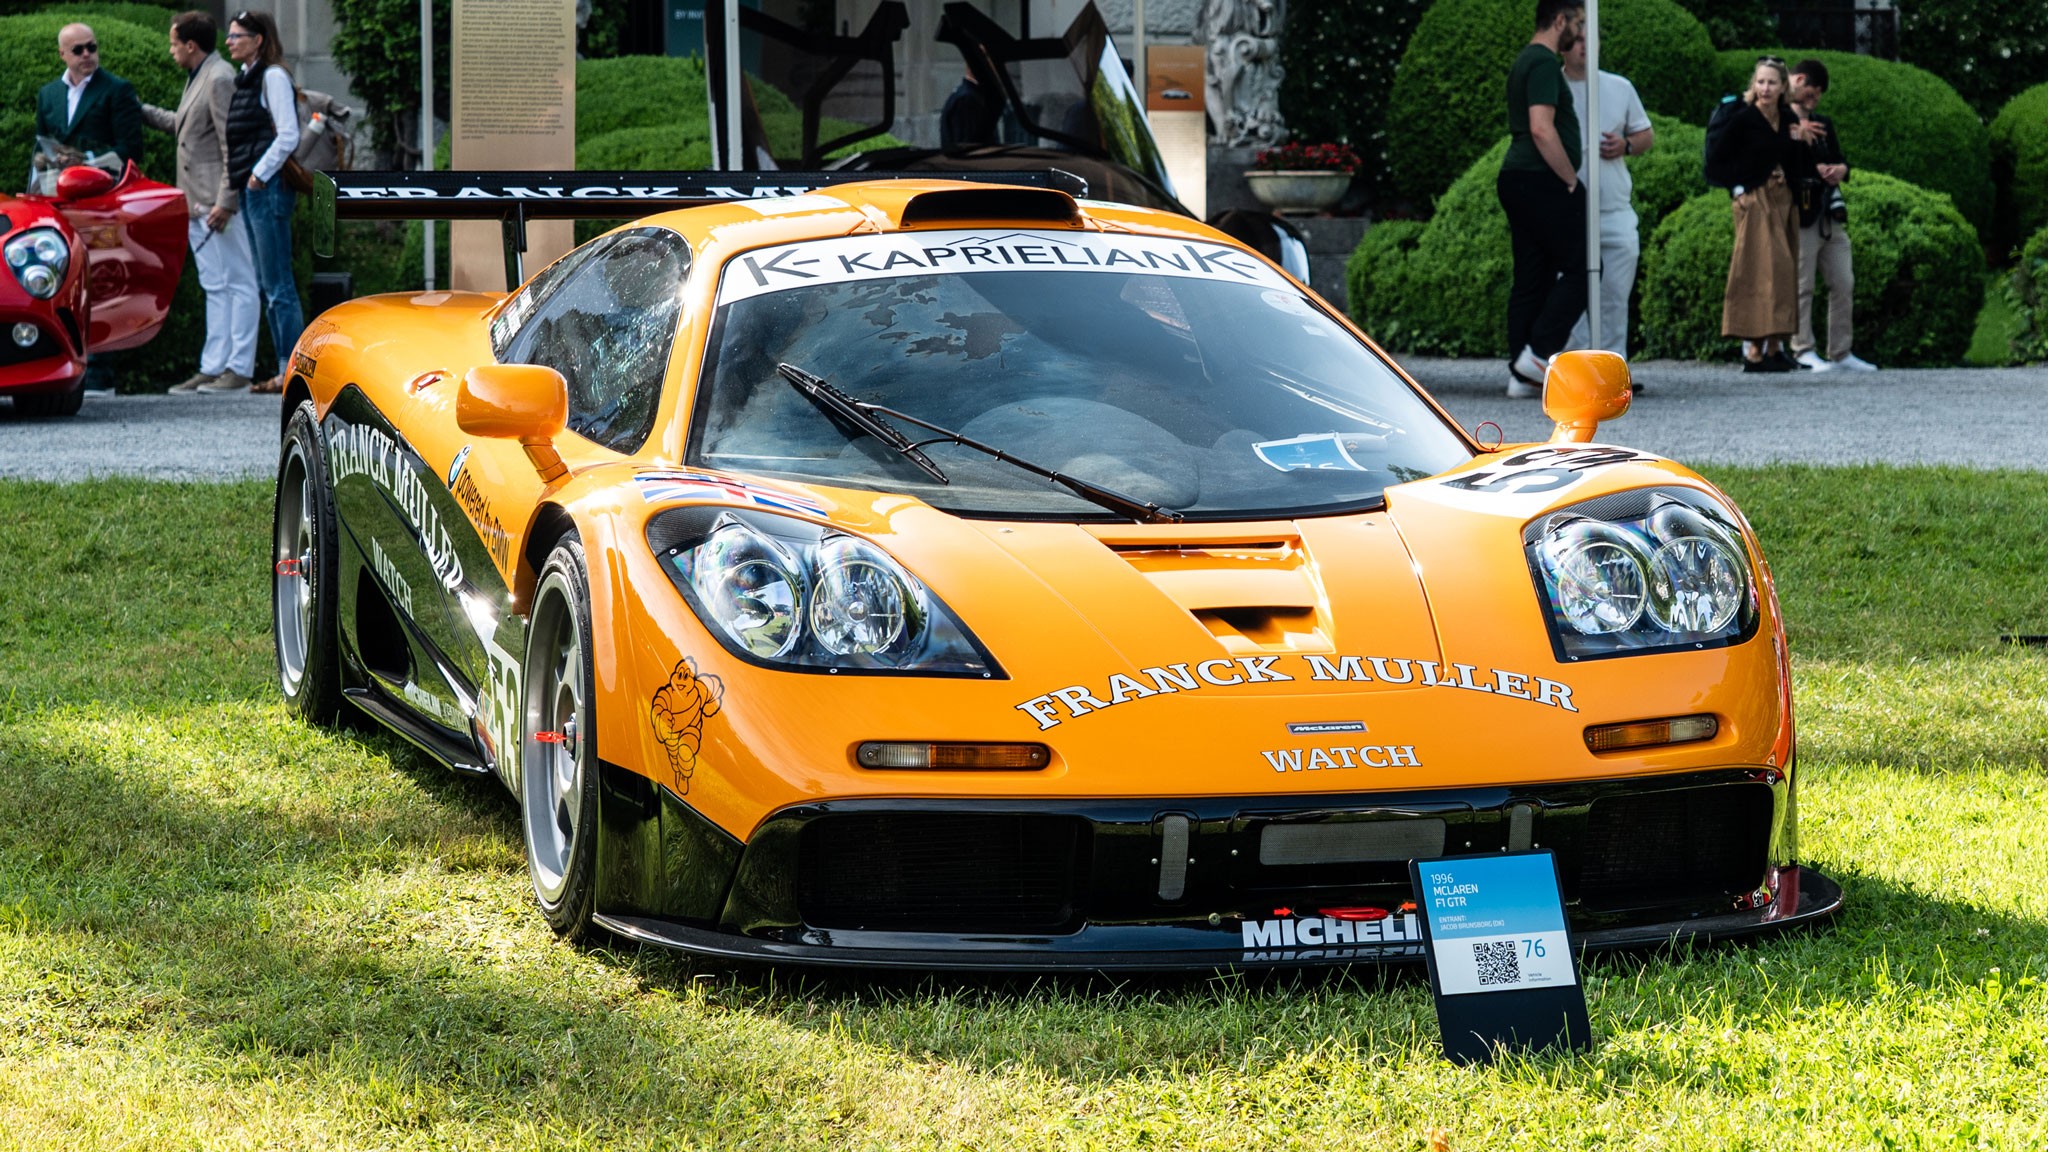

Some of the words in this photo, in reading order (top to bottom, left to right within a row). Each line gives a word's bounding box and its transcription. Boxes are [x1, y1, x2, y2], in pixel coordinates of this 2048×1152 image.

[838, 244, 1190, 274] KAPRIELIAN
[329, 423, 393, 490] FRANCK
[455, 467, 488, 531] powered
[482, 500, 493, 550] by
[372, 536, 414, 620] WATCH
[1015, 655, 1295, 731] FRANCK
[1302, 655, 1579, 713] MULLER
[1261, 745, 1422, 773] WATCH
[1430, 873, 1454, 885] 1996
[1433, 884, 1479, 896] MCLAREN
[1435, 898, 1446, 908] F1
[1447, 896, 1467, 908] GTR
[1242, 913, 1423, 948] MICHELI
[1439, 915, 1467, 923] ENTRANT:
[1441, 923, 1458, 931] JACOB
[1522, 938, 1546, 958] 76
